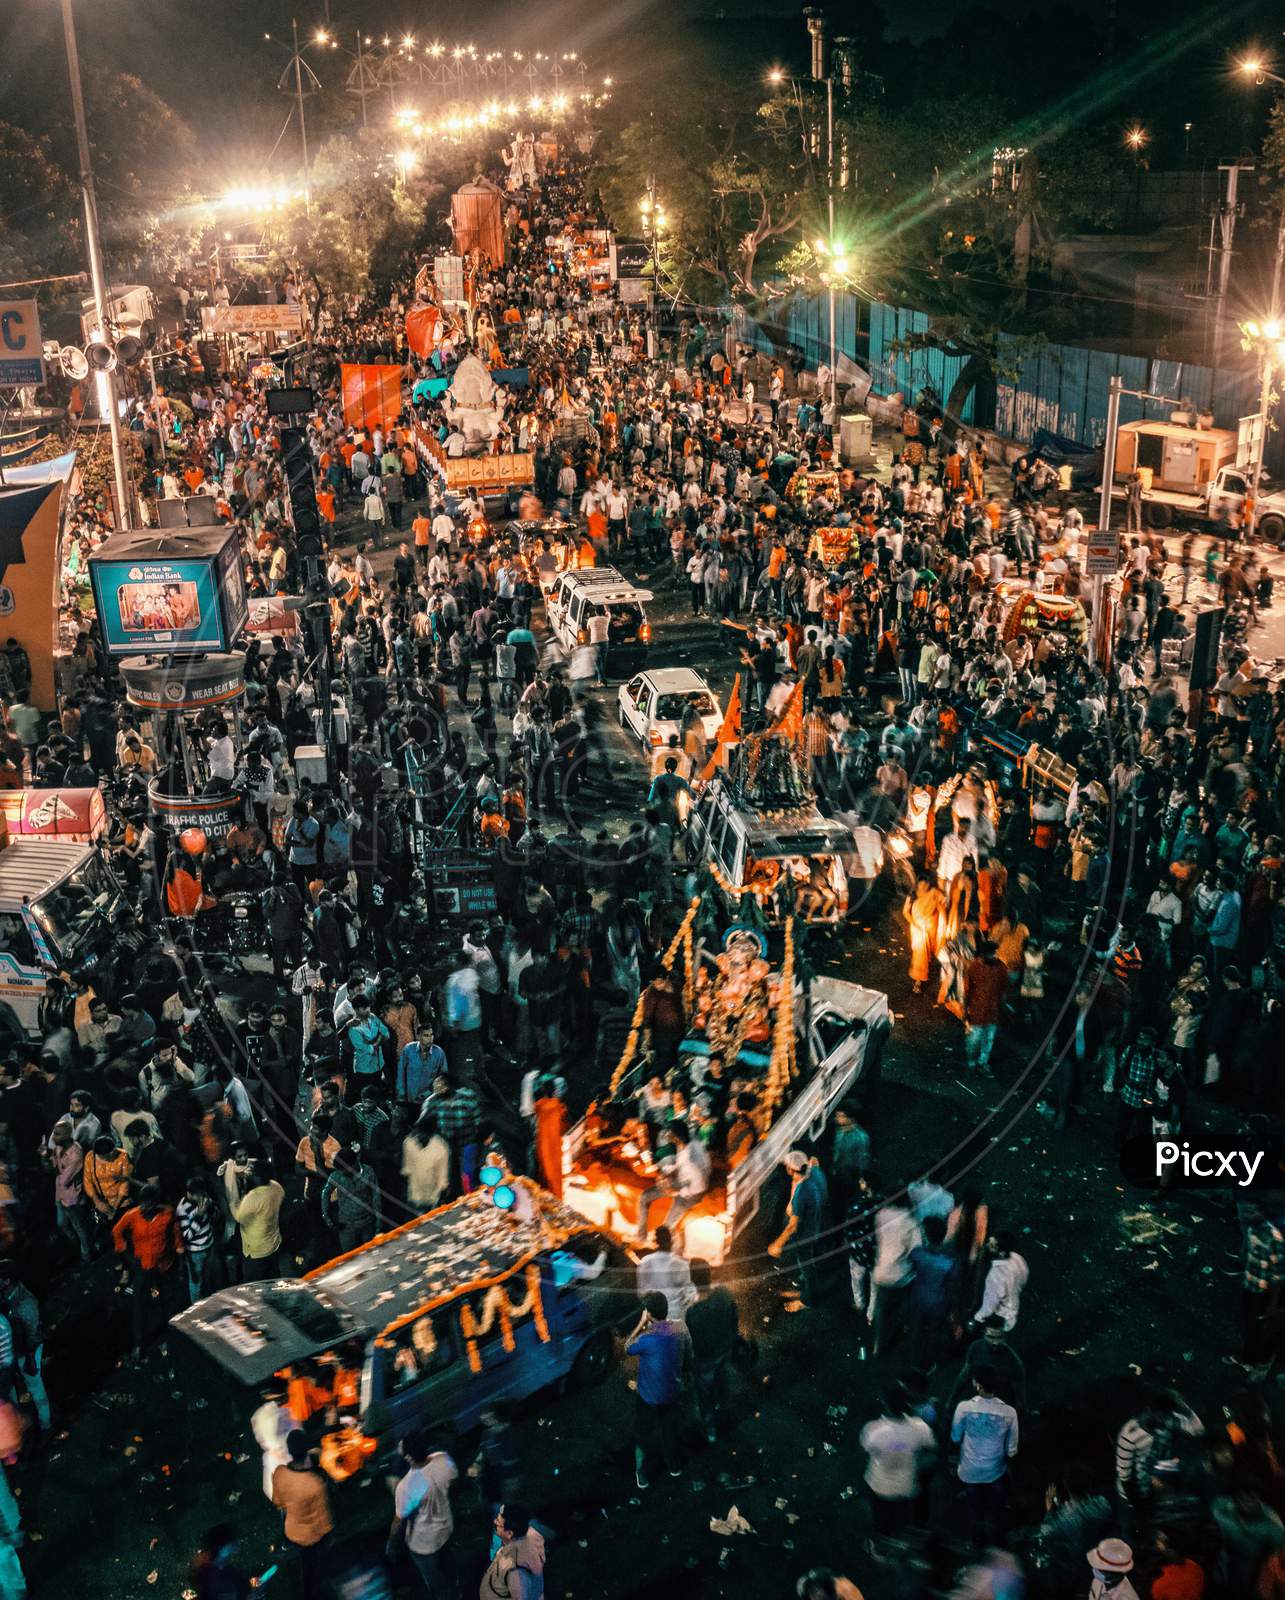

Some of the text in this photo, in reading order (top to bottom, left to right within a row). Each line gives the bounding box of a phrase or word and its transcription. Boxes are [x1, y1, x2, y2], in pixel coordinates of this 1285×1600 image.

[144, 571, 182, 580] Indian Bank
[192, 687, 213, 699] WEAR
[214, 682, 228, 693] SEAT
[164, 811, 229, 826] TRAFFIC POLICE
[471, 888, 482, 897] NOT
